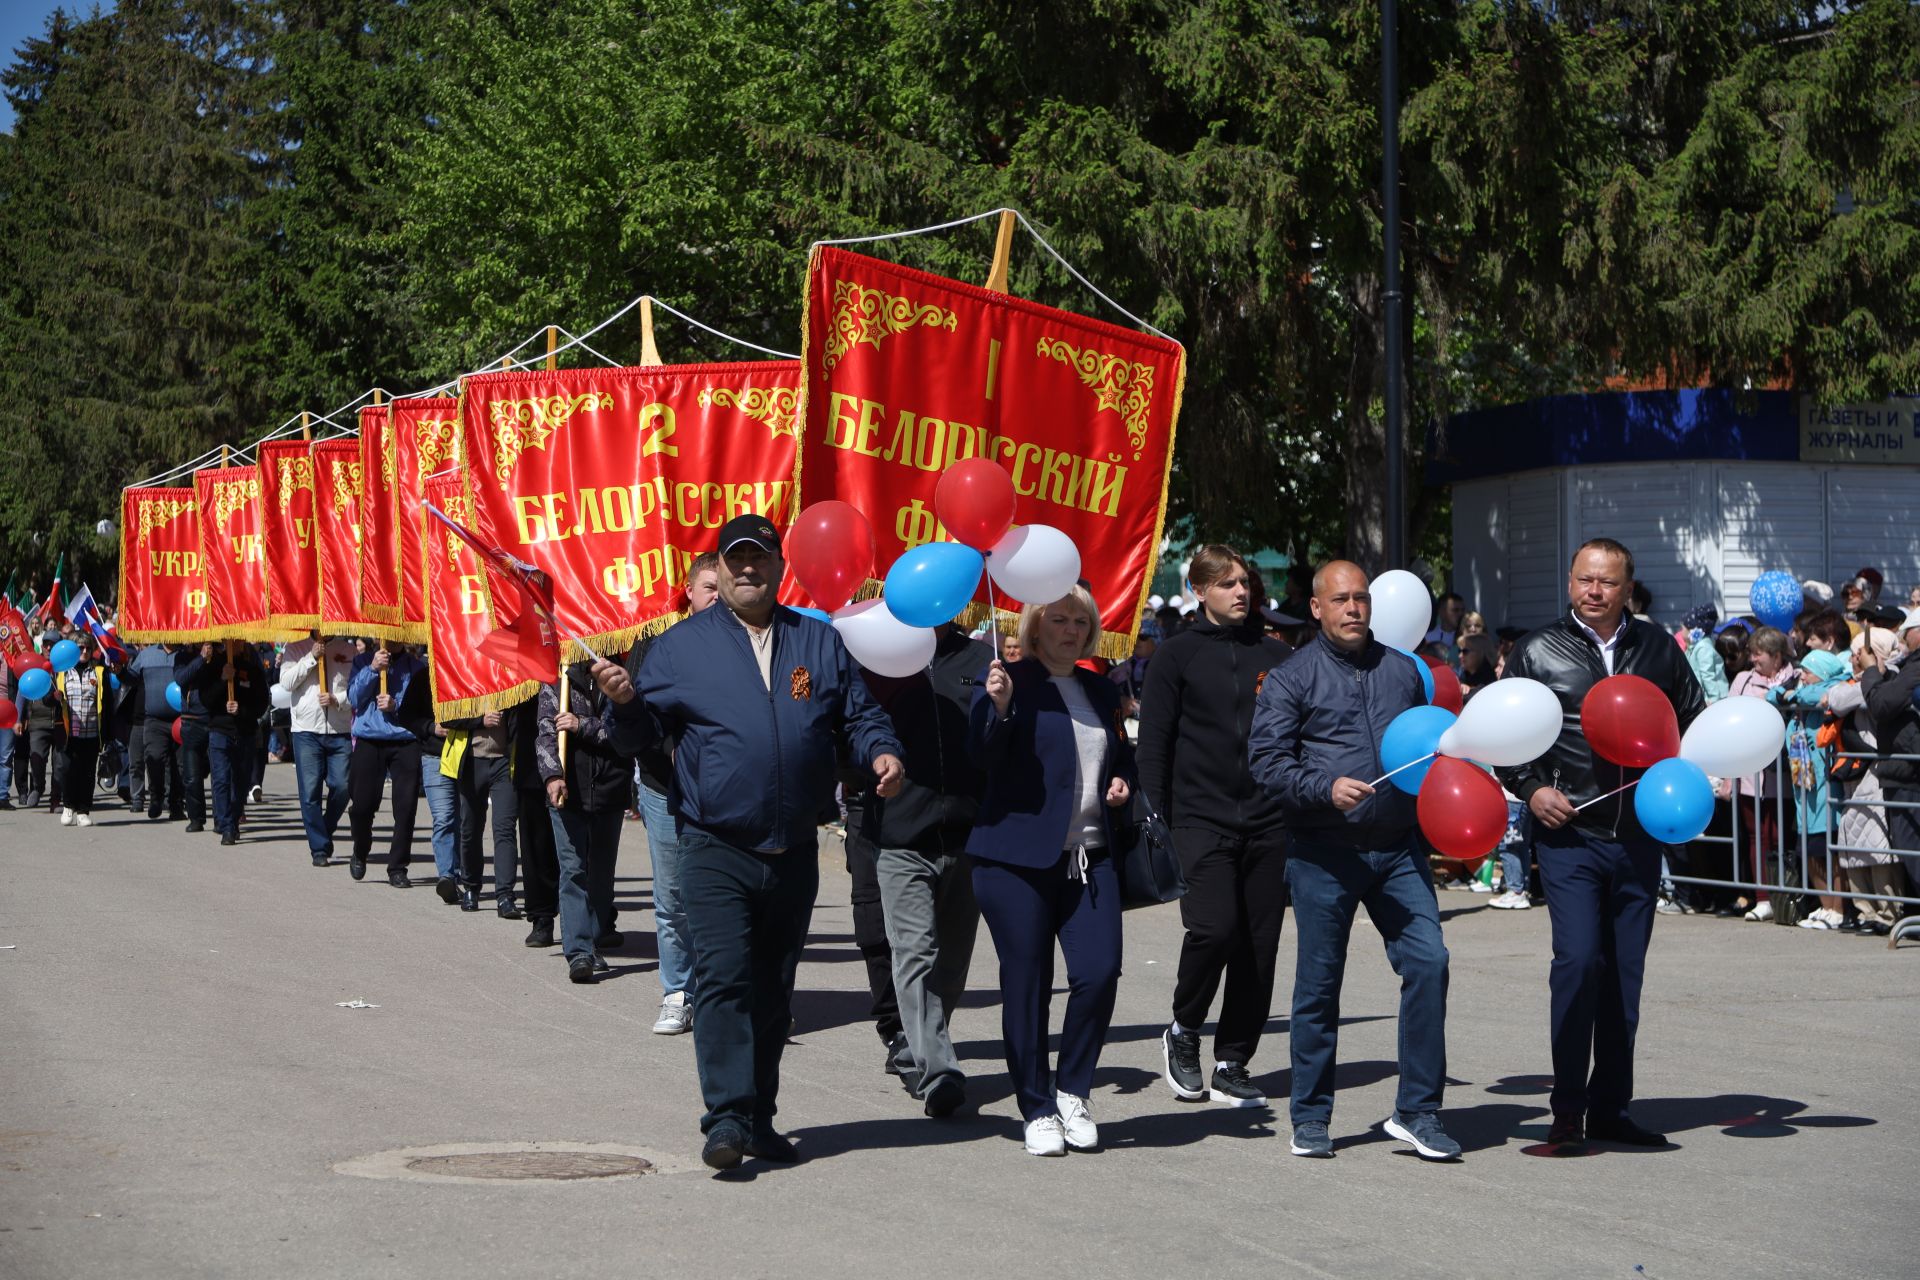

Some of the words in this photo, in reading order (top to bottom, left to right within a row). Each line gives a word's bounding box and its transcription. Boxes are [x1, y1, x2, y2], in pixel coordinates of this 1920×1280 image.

[1808, 409, 1880, 426] ГАЗЕТЫ
[1887, 411, 1899, 427] И
[639, 403, 679, 458] 2
[1808, 431, 1904, 449] ЖУРНАЛЫ
